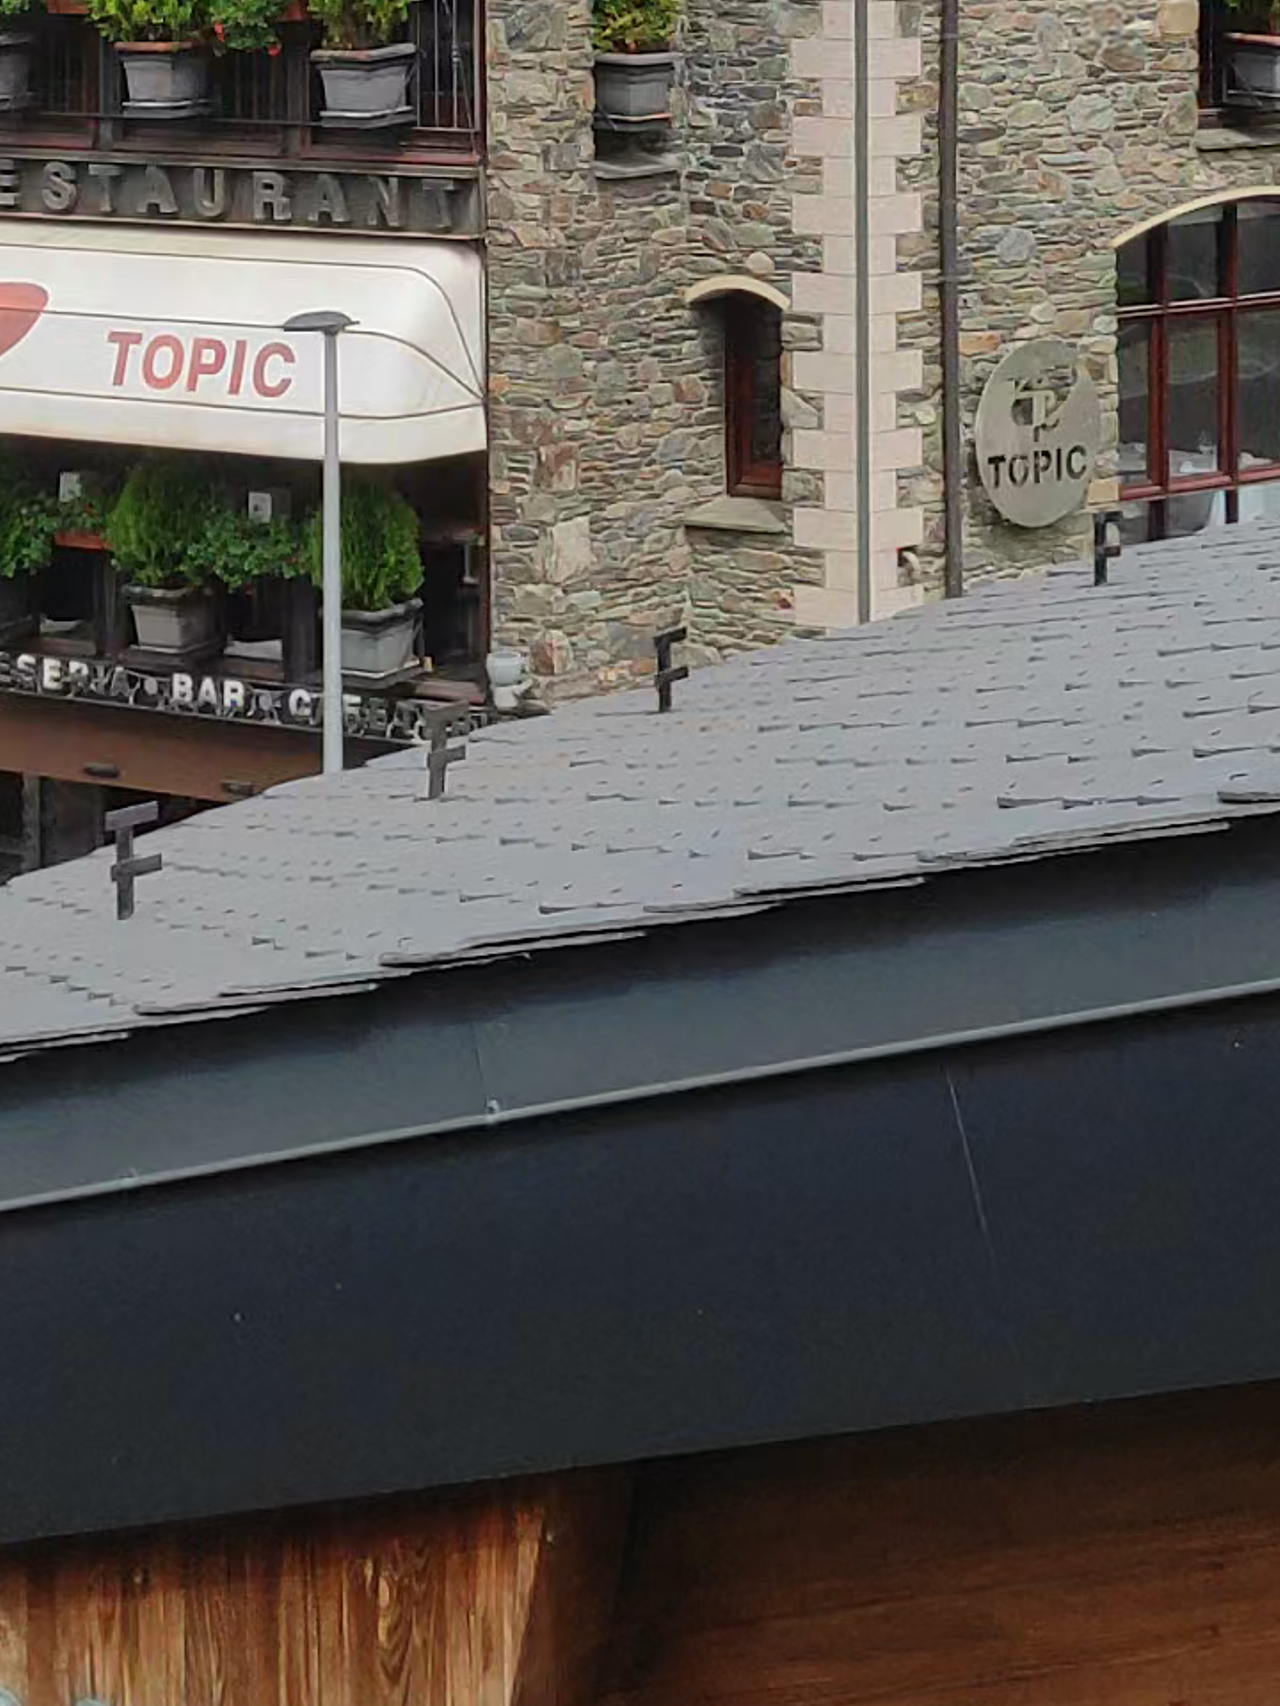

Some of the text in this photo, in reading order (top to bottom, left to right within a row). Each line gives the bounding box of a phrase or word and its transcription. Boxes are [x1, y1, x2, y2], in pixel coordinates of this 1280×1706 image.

[107, 330, 297, 398] TOPIC
[988, 445, 1087, 488] TOPIC
[172, 673, 245, 710] BAR
